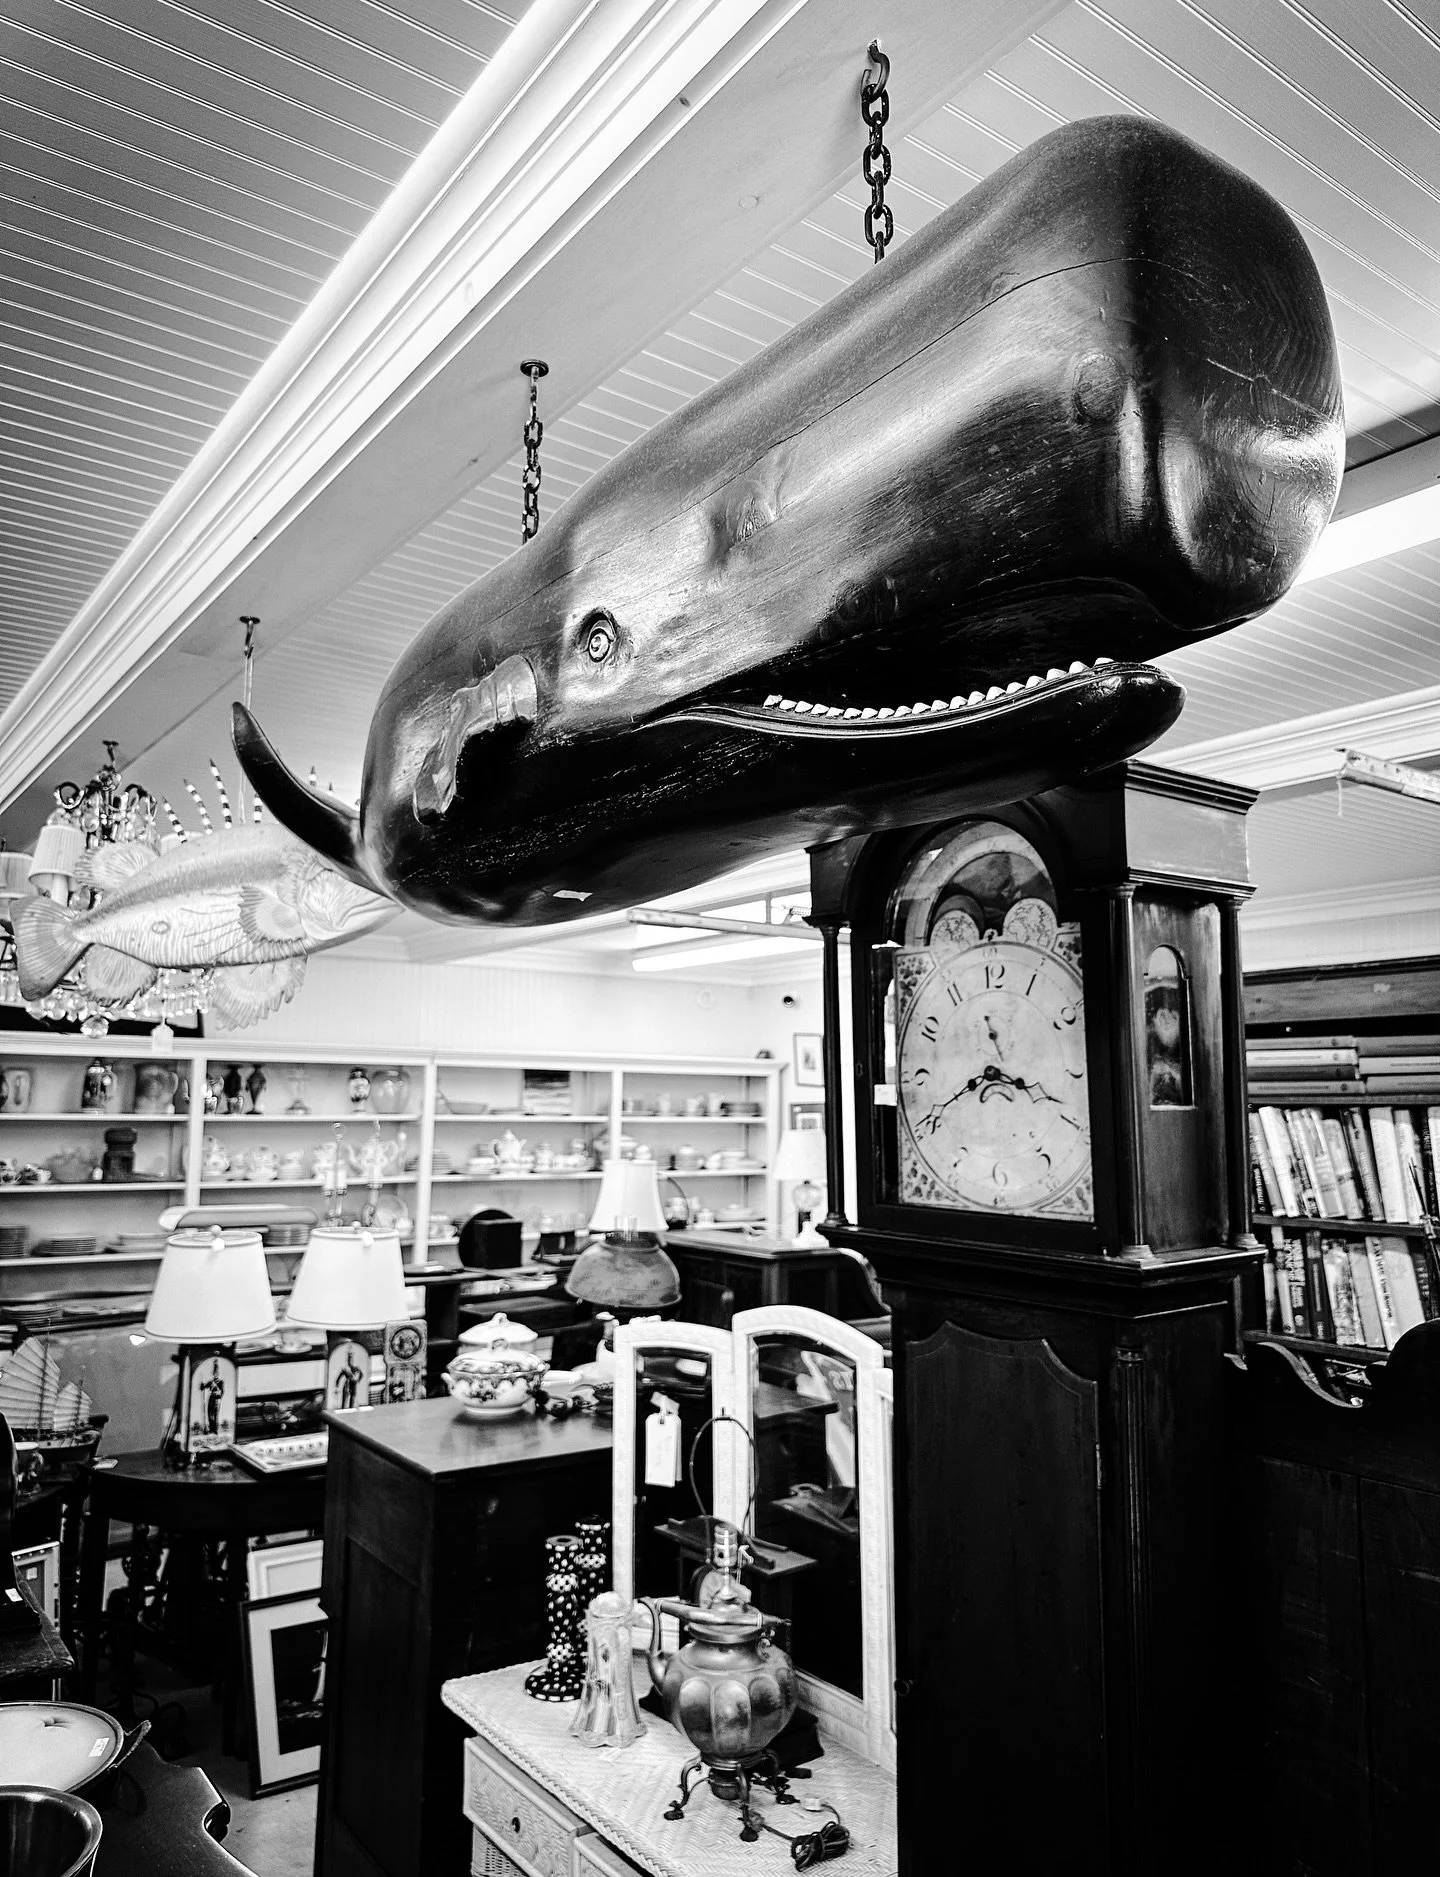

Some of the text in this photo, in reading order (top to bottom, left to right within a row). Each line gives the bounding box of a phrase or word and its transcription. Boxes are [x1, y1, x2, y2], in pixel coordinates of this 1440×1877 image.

[985, 964, 1006, 990] 12
[1025, 973, 1037, 997] 1
[946, 982, 963, 1007] 11
[920, 1015, 940, 1043] 10
